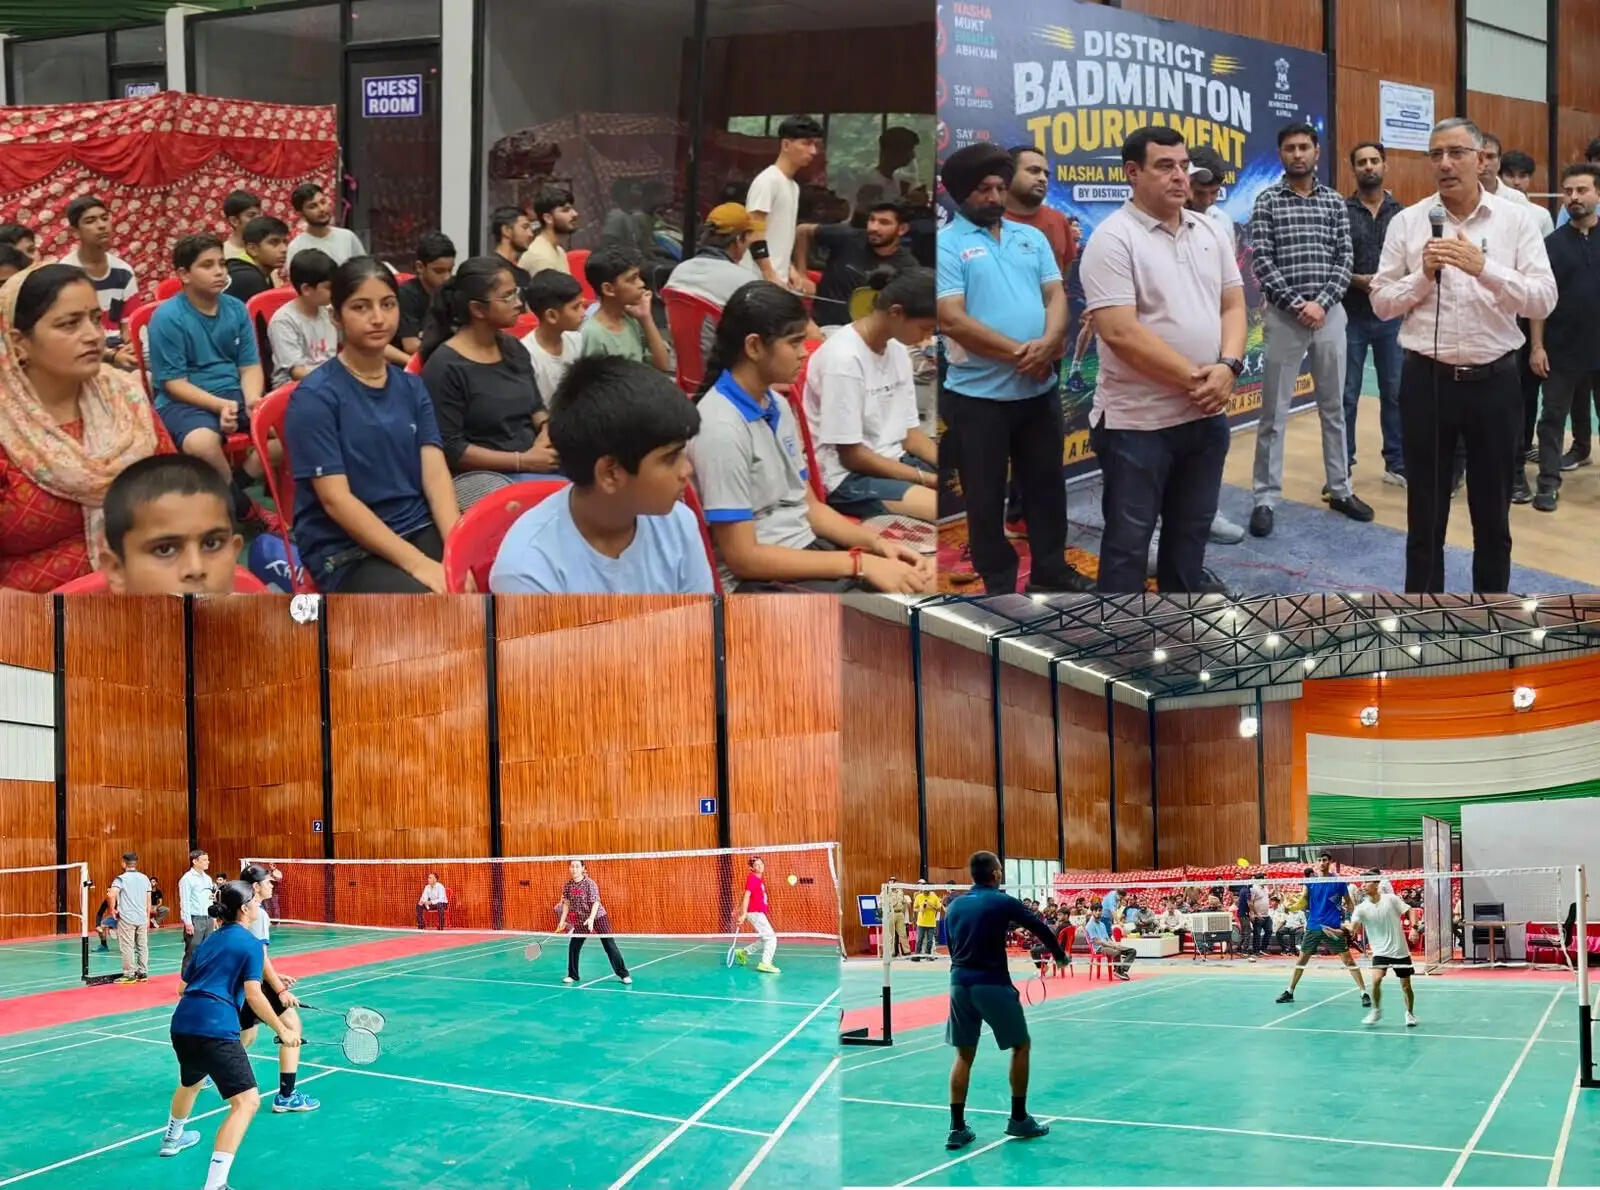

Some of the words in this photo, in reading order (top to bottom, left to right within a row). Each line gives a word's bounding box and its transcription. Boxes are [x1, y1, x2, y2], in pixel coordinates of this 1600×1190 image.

[954, 15, 985, 32] MUKT
[955, 44, 998, 60] ABHIYAN
[1083, 29, 1205, 73] DISTRICT
[367, 79, 417, 97] CHESS
[953, 84, 972, 96] SAY
[1013, 59, 1252, 133] BADMINTON
[369, 97, 415, 113] ROOM
[953, 96, 966, 108] TO
[967, 97, 993, 110] DRUGS
[955, 127, 974, 140] SAY
[1057, 164, 1104, 183] NASHA
[1078, 187, 1091, 199] BY
[1097, 187, 1131, 200] DISTRICT
[704, 801, 711, 812] 1
[315, 822, 321, 831] 2
